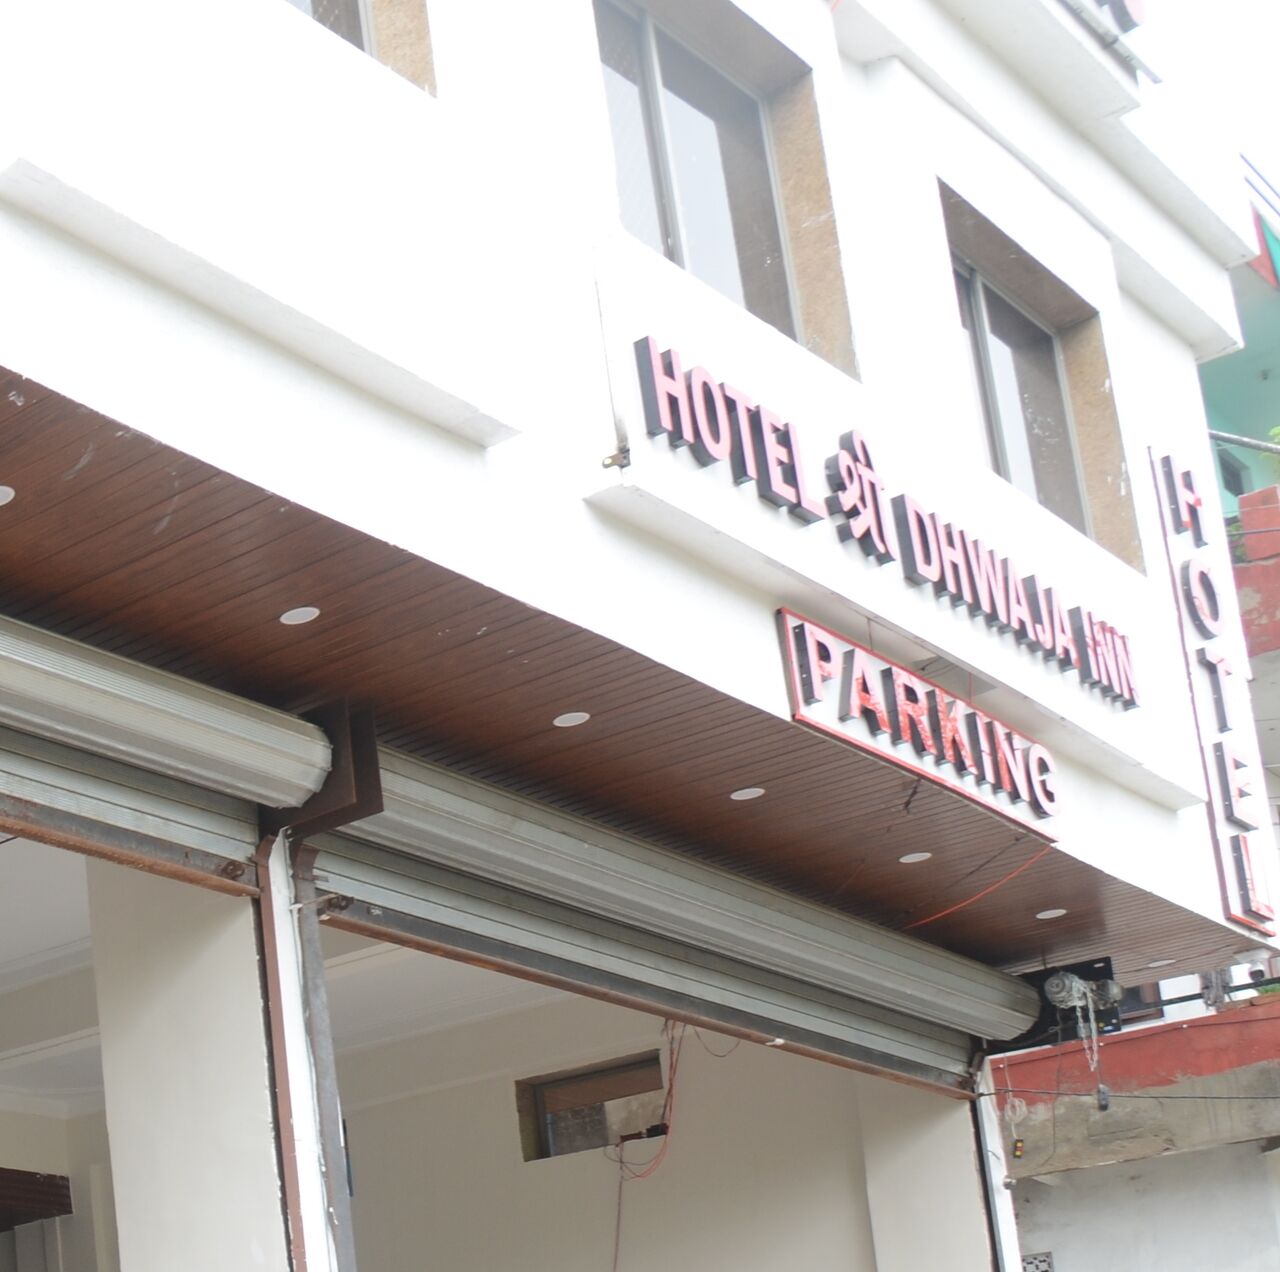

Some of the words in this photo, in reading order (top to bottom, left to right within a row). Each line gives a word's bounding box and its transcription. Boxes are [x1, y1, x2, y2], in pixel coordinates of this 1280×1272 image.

[634, 336, 826, 524] HOTEL
[824, 430, 896, 566] श्री
[891, 493, 1080, 673] DHWAJA
[1068, 605, 1141, 710] INN
[1159, 455, 1275, 923] HOTEL
[794, 622, 1060, 818] PARKING
